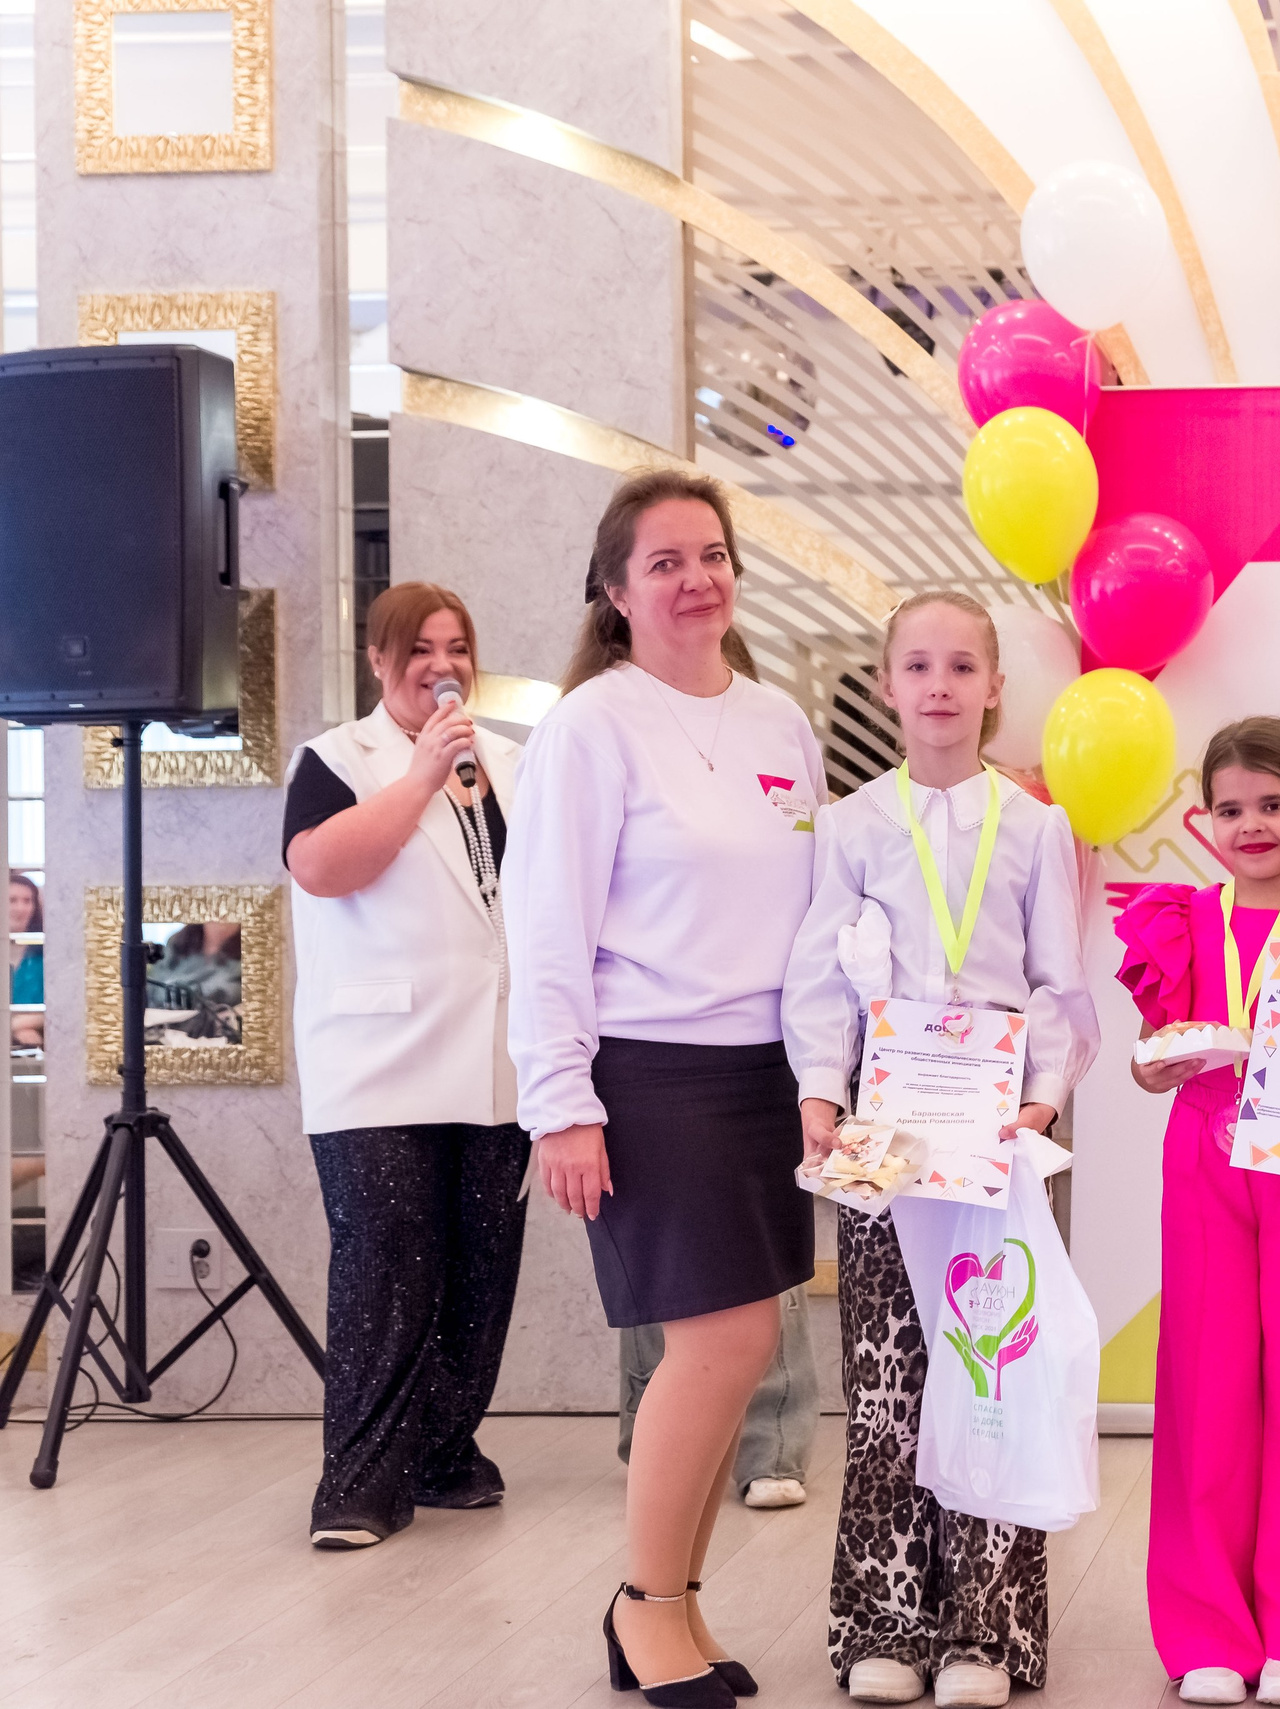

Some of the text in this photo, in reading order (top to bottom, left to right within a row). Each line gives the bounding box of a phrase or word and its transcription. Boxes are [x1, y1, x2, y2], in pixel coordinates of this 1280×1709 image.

[904, 1051, 931, 1059] развитию
[911, 1110, 965, 1119] Барановская
[896, 1117, 927, 1125] Ариана
